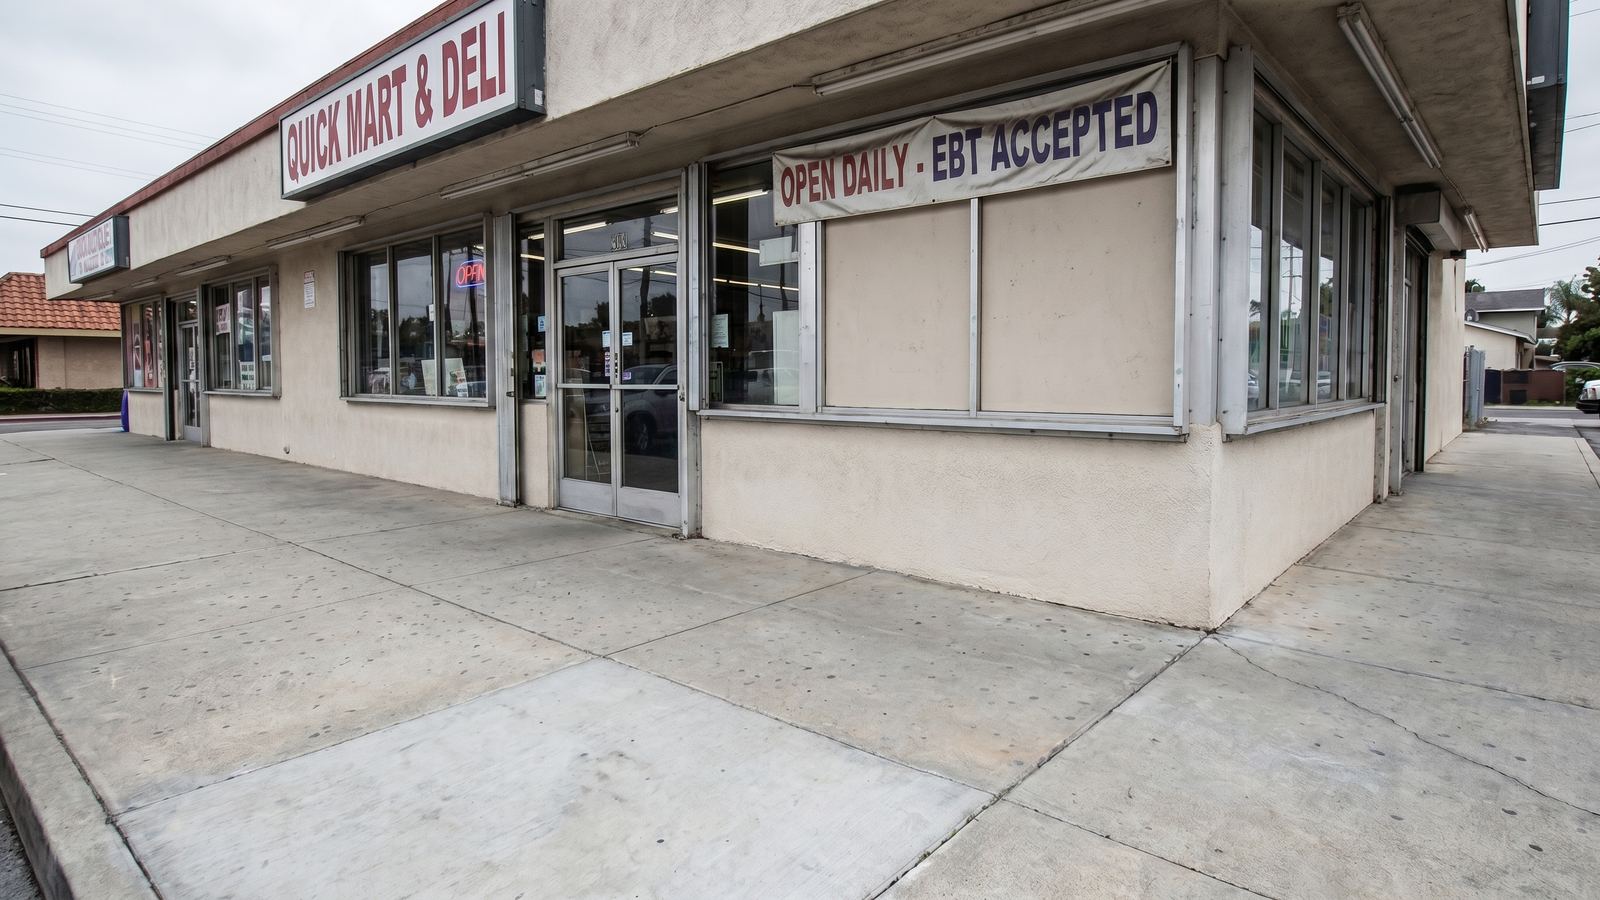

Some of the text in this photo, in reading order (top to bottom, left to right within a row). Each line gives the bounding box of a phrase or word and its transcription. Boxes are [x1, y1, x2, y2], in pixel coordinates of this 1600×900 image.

[288, 11, 506, 183] QUICK MART & DELI
[780, 158, 836, 208] OPEN
[842, 143, 908, 197] DAILY
[932, 127, 982, 182] EBT
[991, 90, 1159, 172] ACCEPTED
